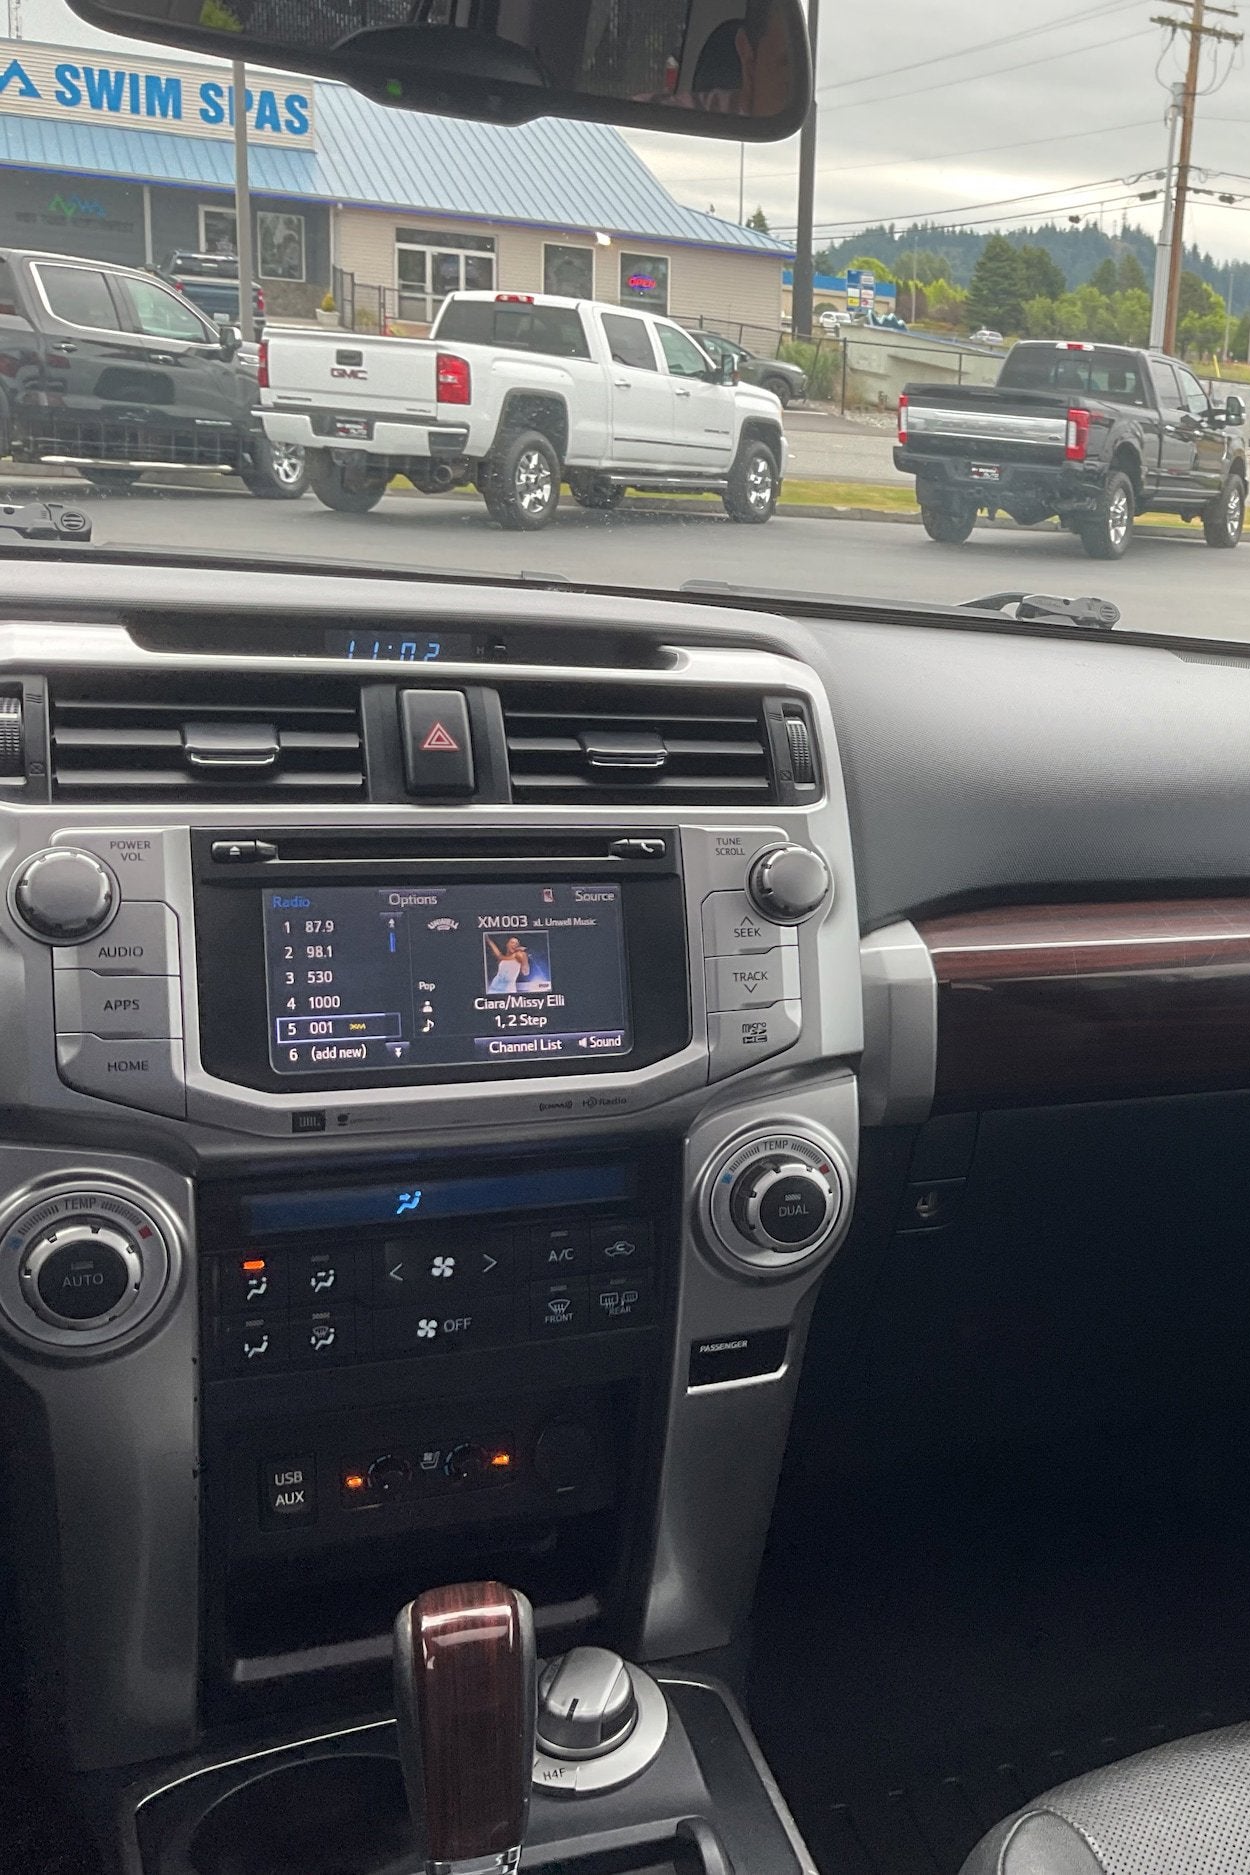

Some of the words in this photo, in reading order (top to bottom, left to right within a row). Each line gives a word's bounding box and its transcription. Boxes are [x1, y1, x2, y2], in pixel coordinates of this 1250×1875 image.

[55, 64, 182, 120] SWIM
[200, 82, 309, 135] SPAS
[627, 275, 656, 289] OPEN
[330, 368, 368, 380] GMC
[349, 640, 440, 661] 11:02
[110, 840, 151, 850] POWER
[716, 838, 741, 846] TUNE
[121, 852, 144, 862] VOL
[715, 847, 746, 856] SCROLL
[272, 896, 311, 908] Radio
[388, 893, 438, 908] Options
[575, 890, 615, 902] Source
[284, 921, 291, 934] 1
[305, 920, 335, 933] 87.9
[545, 918, 572, 927] Unwell
[573, 917, 597, 926] Music
[734, 927, 761, 937] SEEK
[98, 945, 144, 958] AUDIO
[284, 946, 294, 959] 2
[306, 945, 333, 958] 98.1
[285, 972, 295, 985] 3
[307, 971, 333, 984] 530
[733, 971, 768, 982] TRACK
[418, 981, 436, 992] Pop
[103, 999, 140, 1011] APPS
[286, 997, 297, 1010] 4
[308, 995, 341, 1009] 1000
[474, 996, 544, 1010] Ciara/Missy
[547, 994, 565, 1007] Elli
[508, 1014, 517, 1027] 2
[519, 1013, 548, 1028] Step
[287, 1023, 297, 1036] 5
[309, 1021, 333, 1035] 001
[489, 1040, 538, 1054] Channel
[540, 1038, 563, 1051] List
[590, 1035, 622, 1049] Sound
[289, 1048, 299, 1061] 6
[311, 1045, 337, 1062] (add
[339, 1043, 367, 1059] new)
[107, 1060, 149, 1072] HOME
[762, 1140, 789, 1151] TEMP
[64, 1197, 97, 1211] TEMP
[779, 1205, 809, 1217] DUAL
[548, 1248, 574, 1262] A/C
[62, 1273, 104, 1288] AUTO
[545, 1312, 574, 1324] FRONT
[608, 1305, 632, 1317] REAR
[443, 1317, 472, 1333] OFF
[699, 1340, 748, 1353] PASSENGER
[274, 1471, 303, 1486] USB
[275, 1490, 305, 1506] AUX
[543, 1767, 567, 1781] H4F
